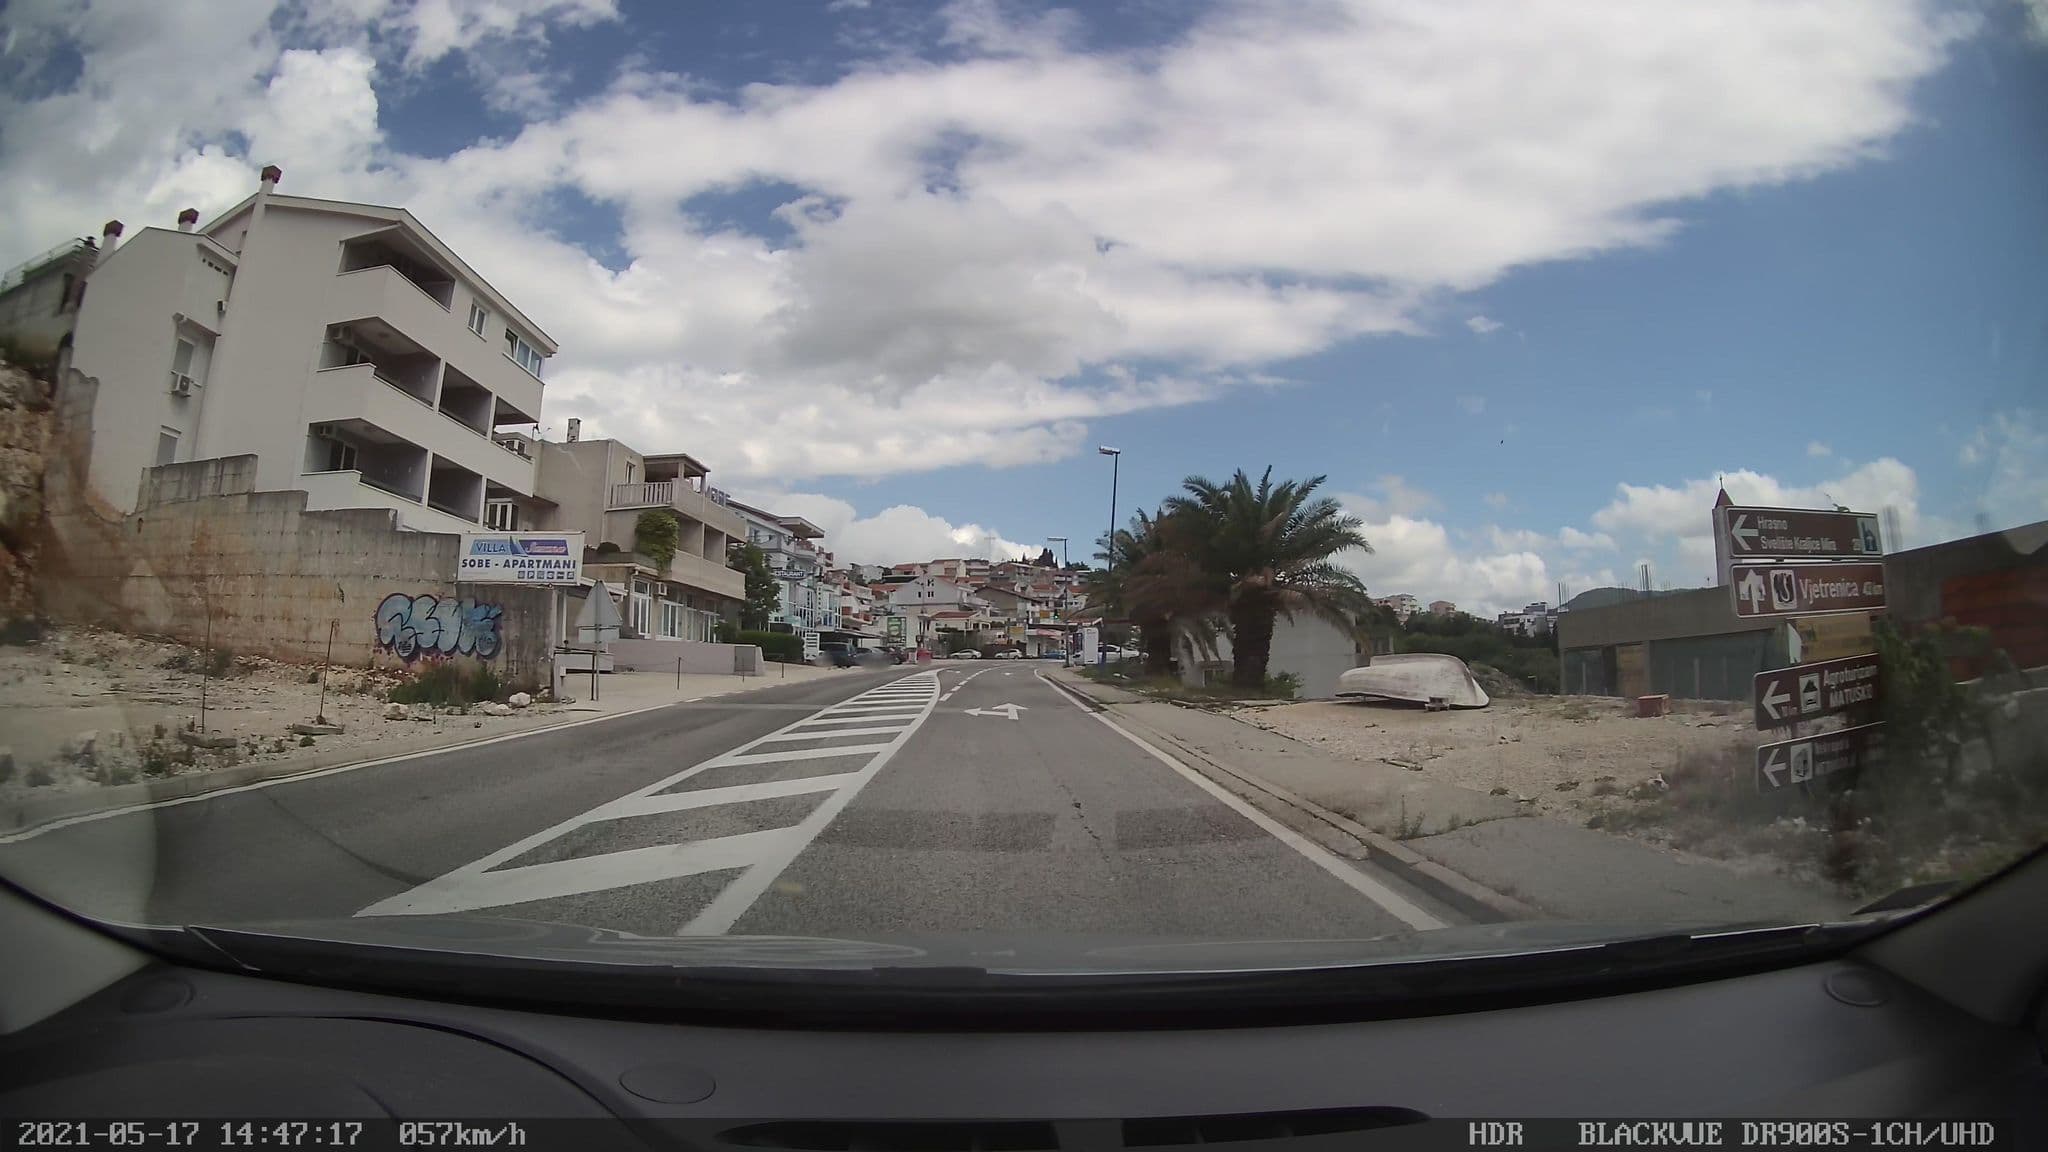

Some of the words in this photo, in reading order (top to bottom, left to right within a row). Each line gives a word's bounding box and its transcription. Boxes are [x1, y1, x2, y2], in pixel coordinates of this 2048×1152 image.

[1757, 515, 1788, 530] Hrasno
[476, 542, 507, 553] VILLA
[461, 559, 492, 568] SOBE
[502, 559, 577, 569] APARTMANI
[1800, 578, 1860, 604] Vjetrenica
